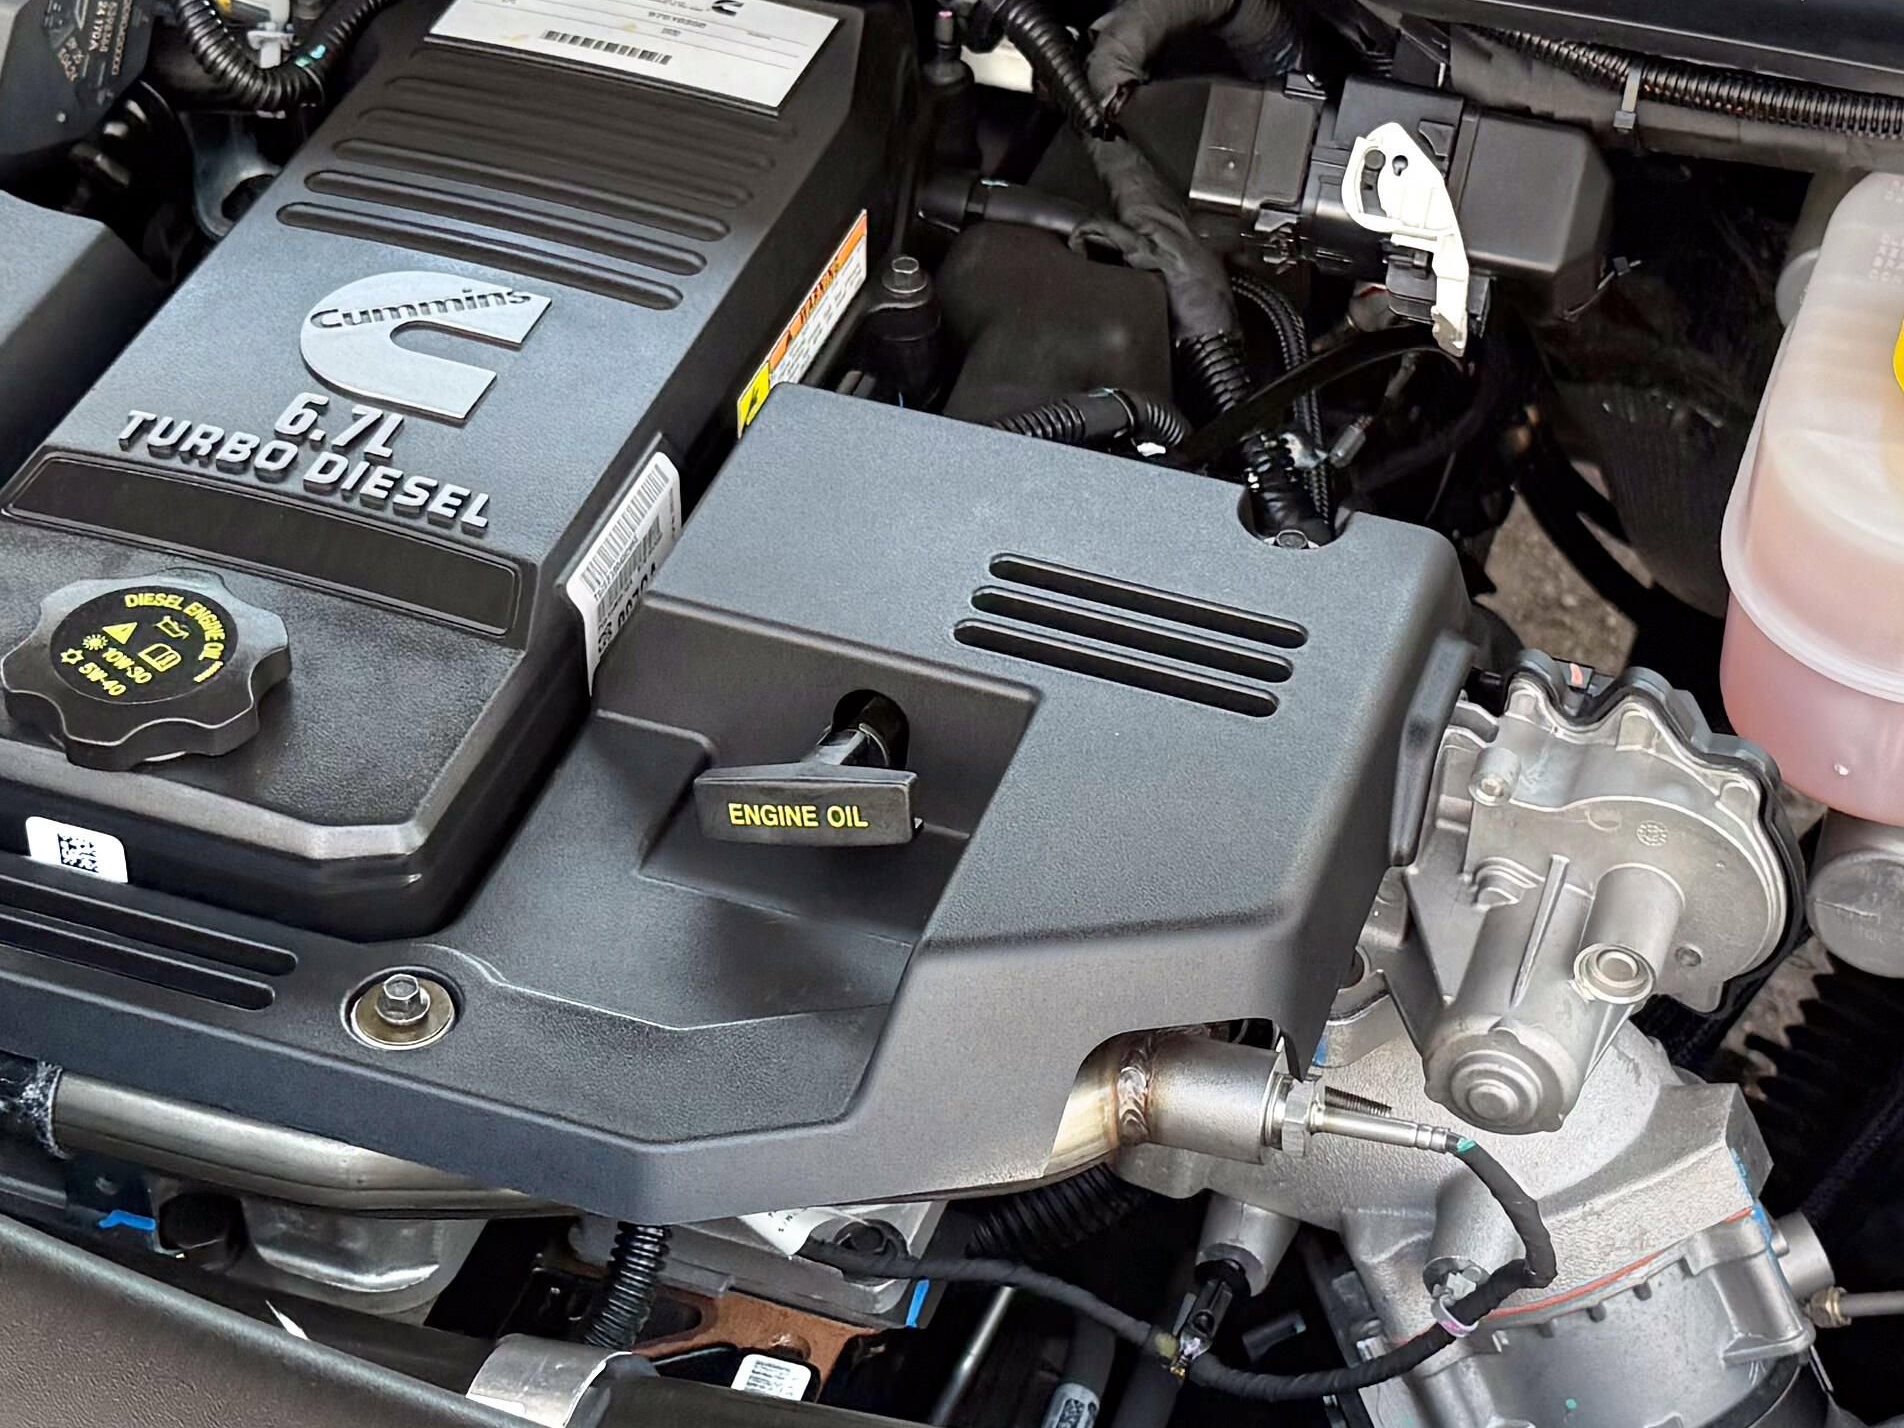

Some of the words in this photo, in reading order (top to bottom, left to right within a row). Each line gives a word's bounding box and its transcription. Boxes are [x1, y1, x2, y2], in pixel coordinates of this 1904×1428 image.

[308, 285, 534, 330] Cummins
[274, 391, 405, 460] 6.7L
[117, 408, 299, 483] TURBO
[302, 450, 491, 536] DIESEL
[124, 592, 185, 612] DIESEL
[183, 601, 227, 643] ENGINE
[101, 646, 153, 685] 10W-30
[198, 641, 225, 661] OIL
[78, 661, 127, 697] 5W-40
[727, 802, 820, 828] ENGINE
[826, 805, 870, 829] OIL
